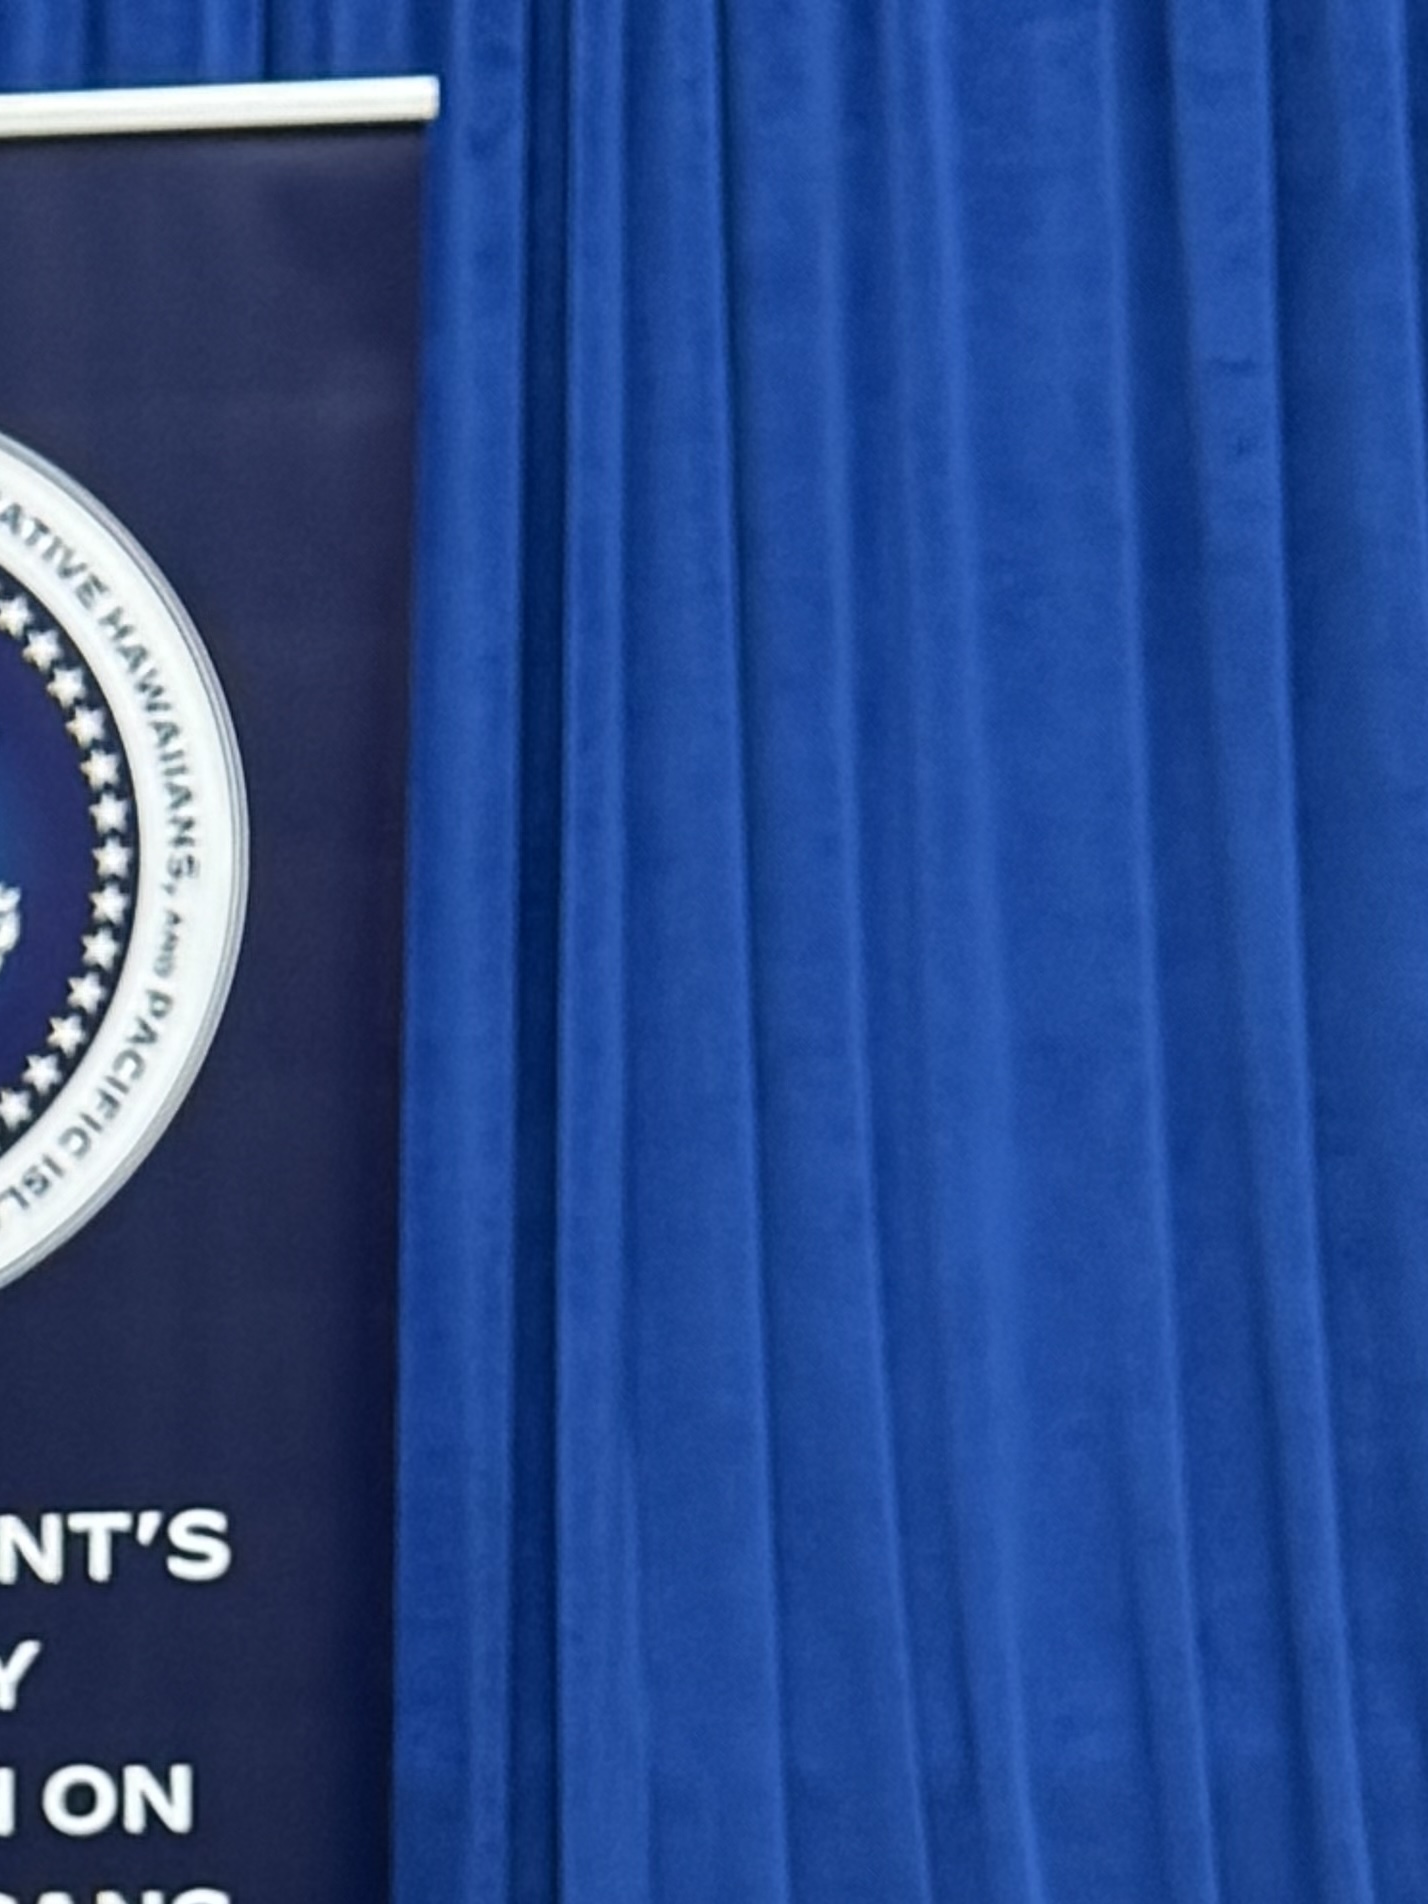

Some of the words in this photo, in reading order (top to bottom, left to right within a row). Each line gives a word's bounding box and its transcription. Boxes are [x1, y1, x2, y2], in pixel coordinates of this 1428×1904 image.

[98, 606, 199, 896] HAWAIIANS,
[58, 989, 173, 1157] PACIFIC
[41, 1762, 194, 1837] ON
